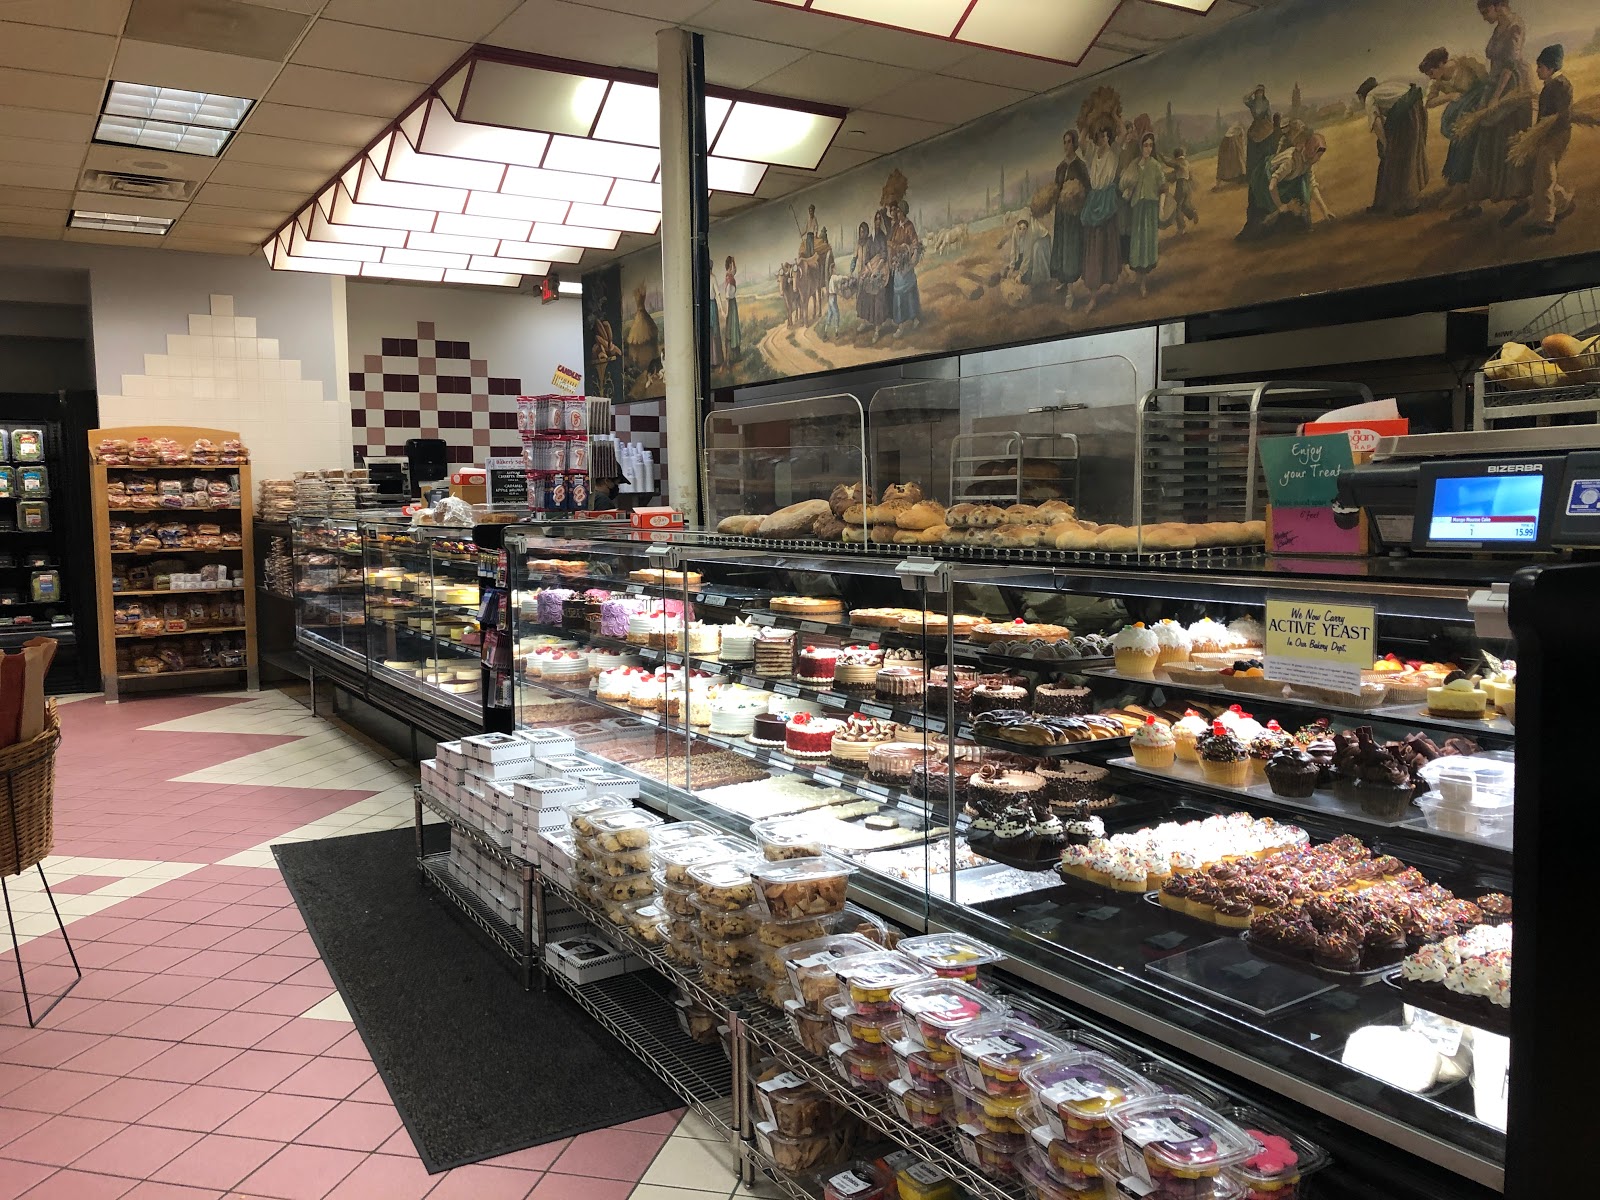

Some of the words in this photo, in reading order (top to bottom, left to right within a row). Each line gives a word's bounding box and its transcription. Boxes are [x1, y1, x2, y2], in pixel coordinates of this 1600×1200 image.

[557, 364, 582, 381] CANDLES
[1291, 443, 1322, 464] Enjoy
[1279, 469, 1307, 486] your
[1310, 463, 1341, 477] Treat
[1487, 463, 1543, 473] BIZERBA
[1515, 528, 1534, 536] 15.99
[1291, 608, 1302, 620] We
[1305, 609, 1321, 621] Now
[1324, 610, 1345, 626] Carry
[1269, 618, 1316, 635] ACTIVE
[1322, 623, 1370, 641] YEAST
[1287, 637, 1293, 646] In
[1295, 638, 1307, 647] Our
[1309, 639, 1329, 652] Bakery
[1331, 641, 1347, 655] Dept.
